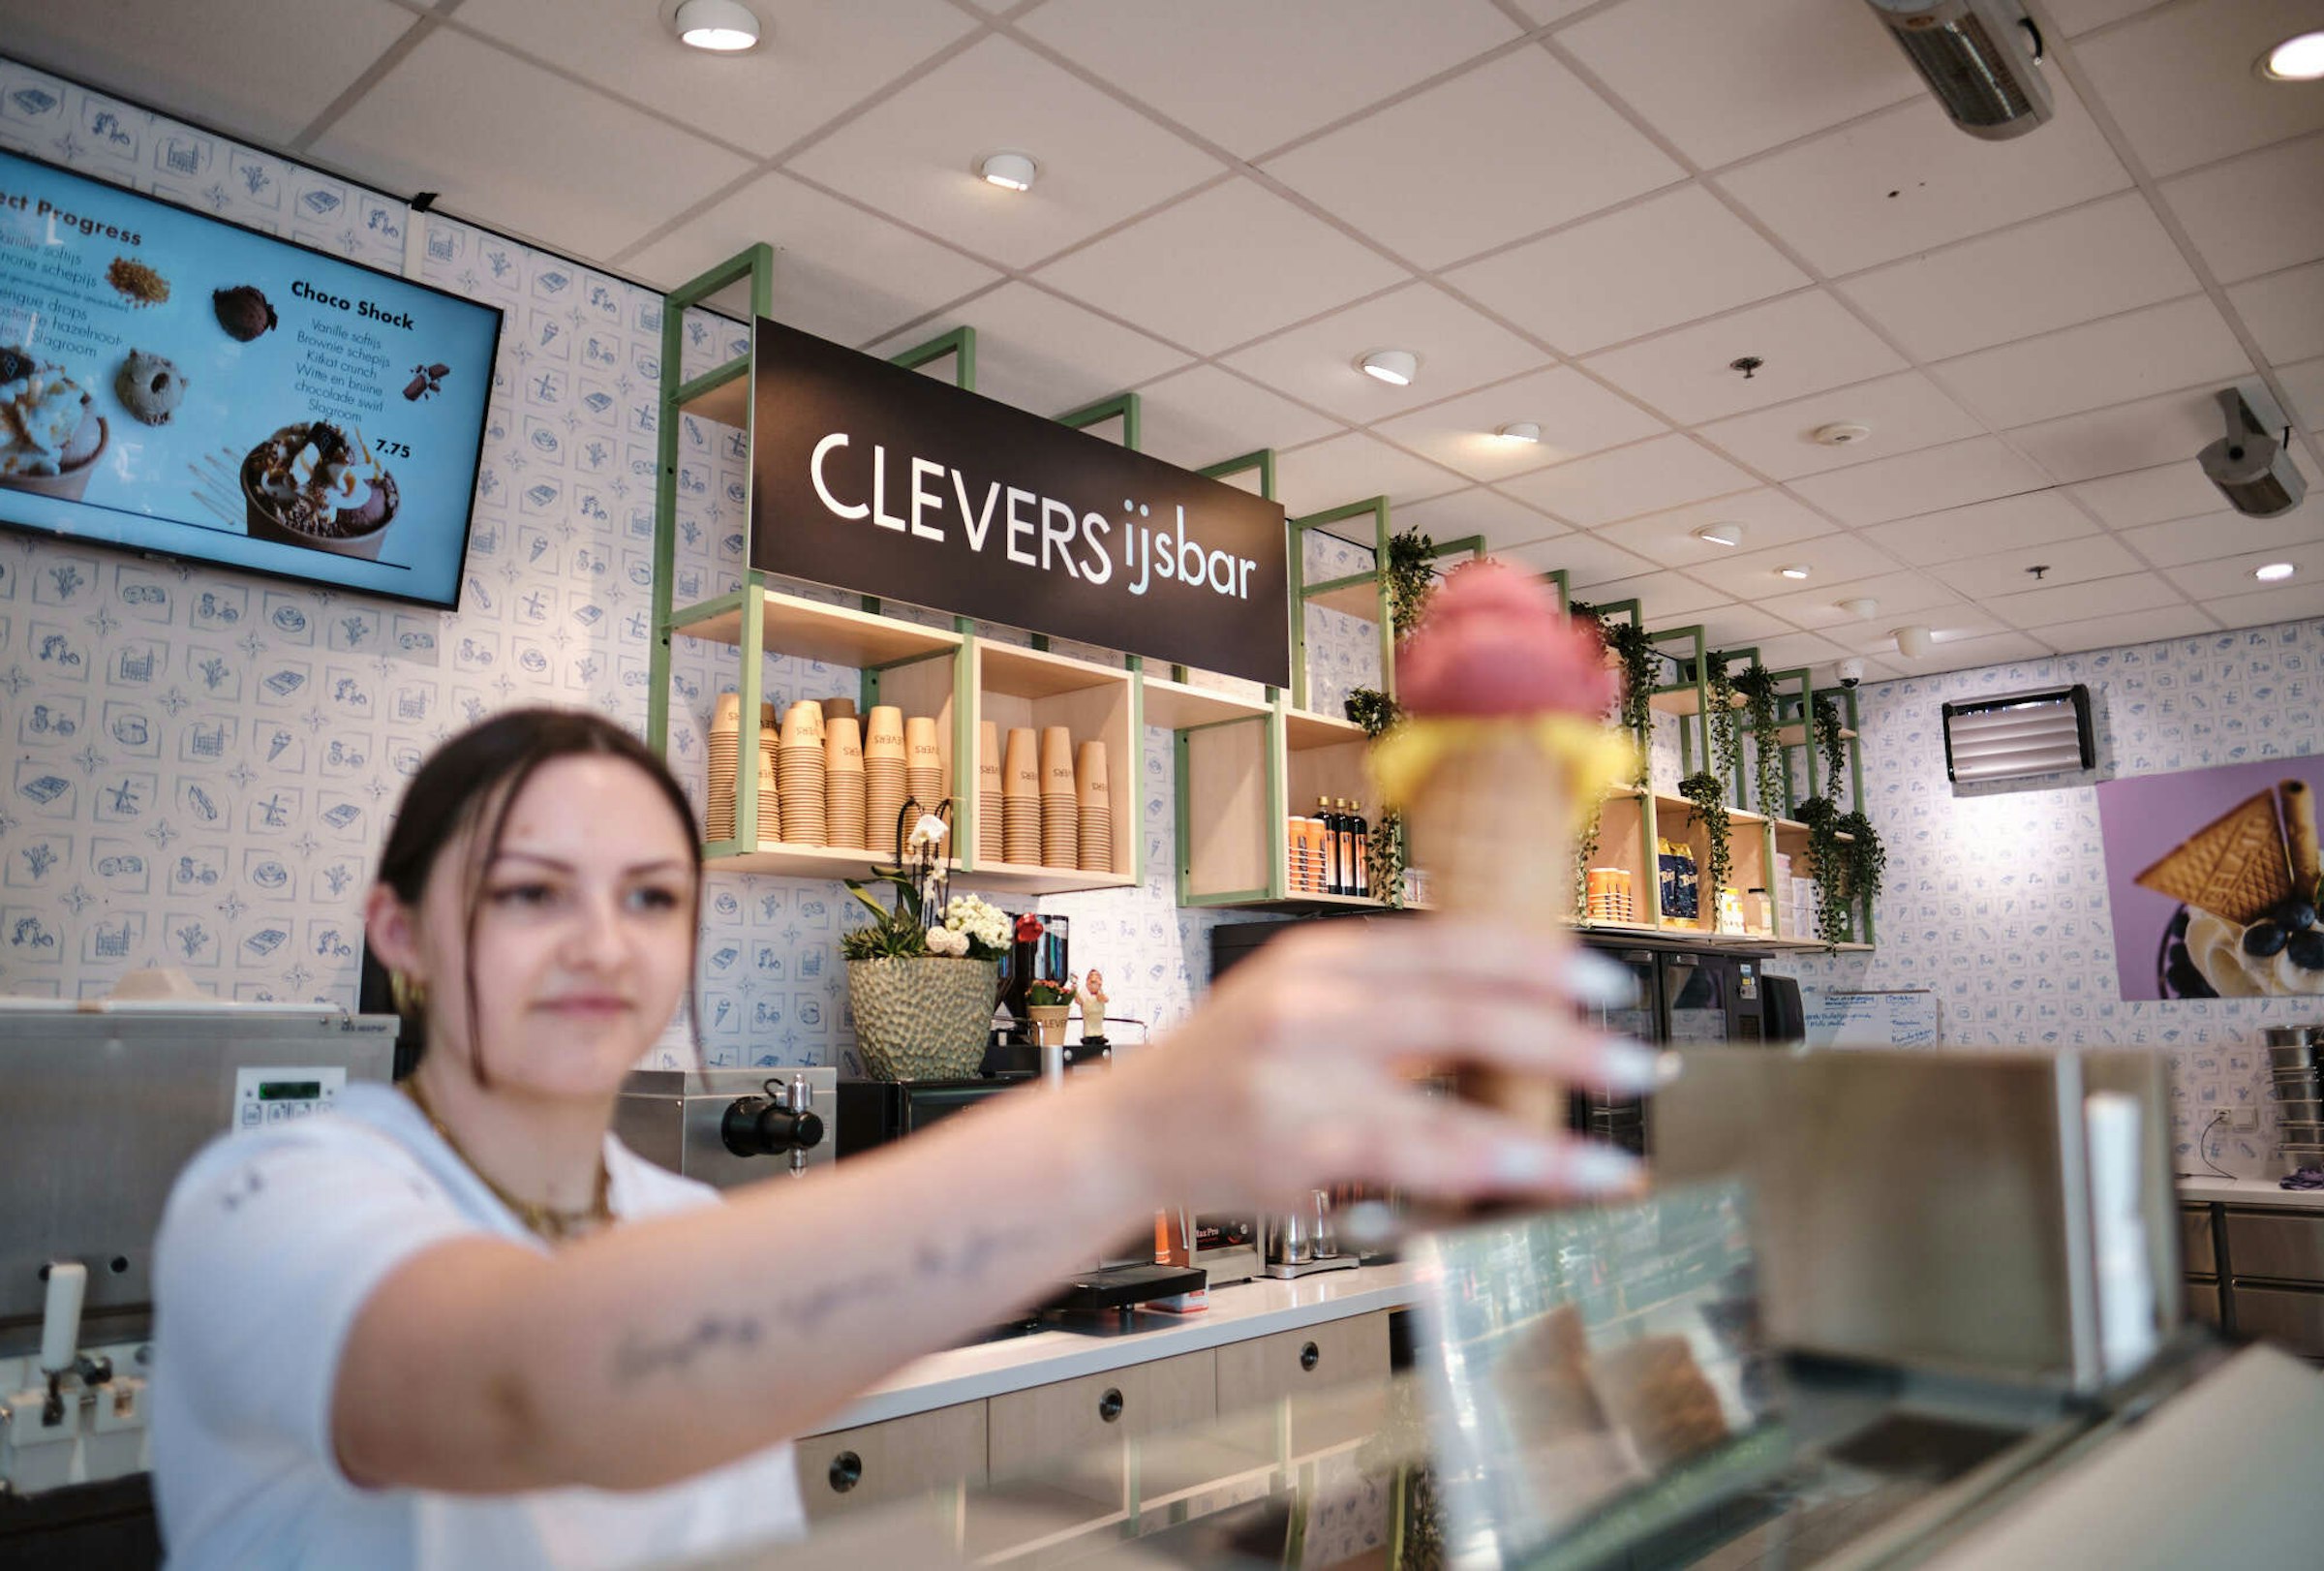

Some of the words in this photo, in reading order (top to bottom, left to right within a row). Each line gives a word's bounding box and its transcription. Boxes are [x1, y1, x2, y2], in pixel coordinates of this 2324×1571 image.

[37, 199, 142, 246] Progress
[42, 261, 97, 289] schepijs
[48, 298, 88, 321] drops
[291, 281, 351, 310] Choco
[357, 301, 414, 330] Shock
[33, 329, 97, 357] Slagroom
[297, 331, 344, 354] Brownie
[347, 347, 390, 369] schepijs
[312, 318, 349, 339] Vanille
[352, 331, 382, 350] softijs
[296, 362, 327, 382] Witte
[331, 375, 345, 385] en
[349, 377, 382, 396] bruine
[306, 350, 338, 368] Kitkat
[341, 363, 377, 379] crunch
[294, 379, 354, 405] chocolade
[357, 396, 383, 413] swirl
[308, 399, 362, 423] Slagroom
[376, 439, 411, 458] 7.75
[810, 433, 1113, 585] CLEVERS
[1123, 499, 1256, 599] ijsbar
